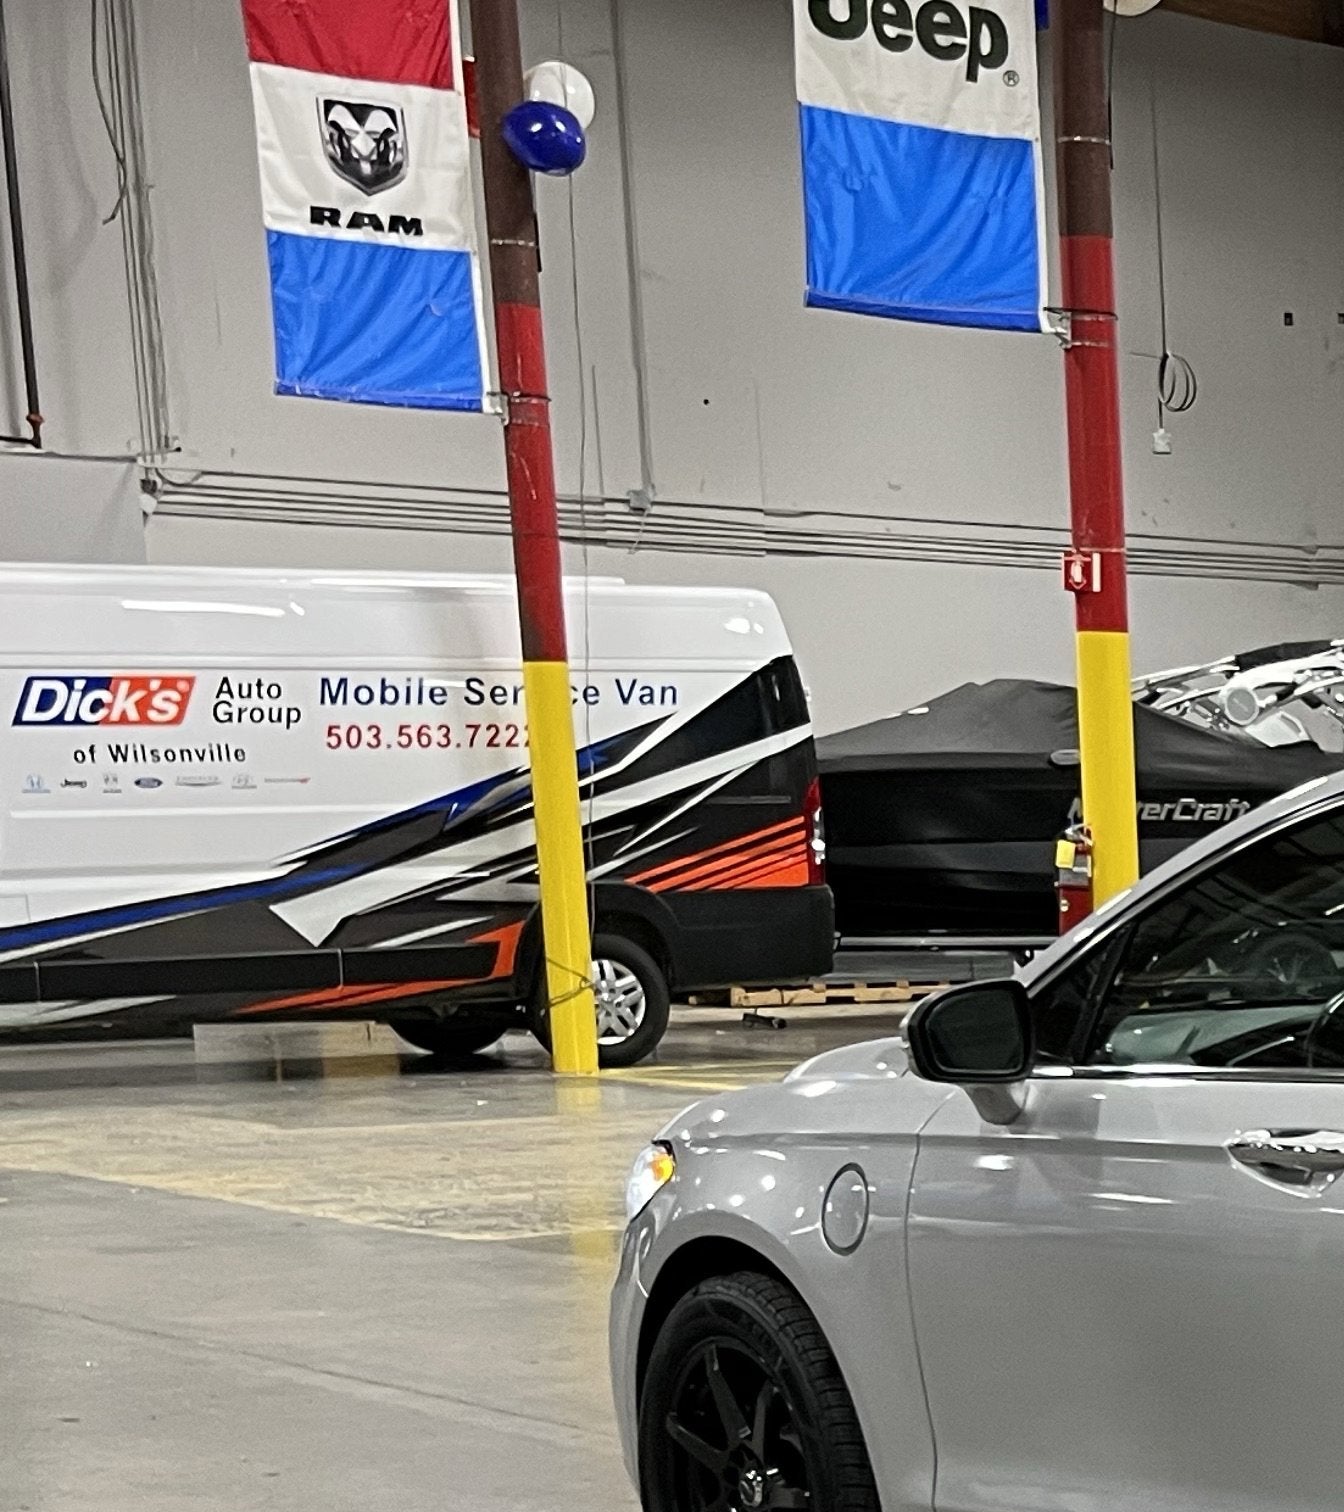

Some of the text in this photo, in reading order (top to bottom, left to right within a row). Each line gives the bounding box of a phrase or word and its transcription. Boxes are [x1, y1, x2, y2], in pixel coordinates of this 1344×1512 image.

[310, 205, 423, 236] RAM
[21, 679, 183, 723] Dick's
[215, 676, 282, 699] Auto
[319, 677, 678, 706] Mobile Sere Van
[213, 700, 302, 729] Group
[73, 743, 246, 764] of Wilsonville
